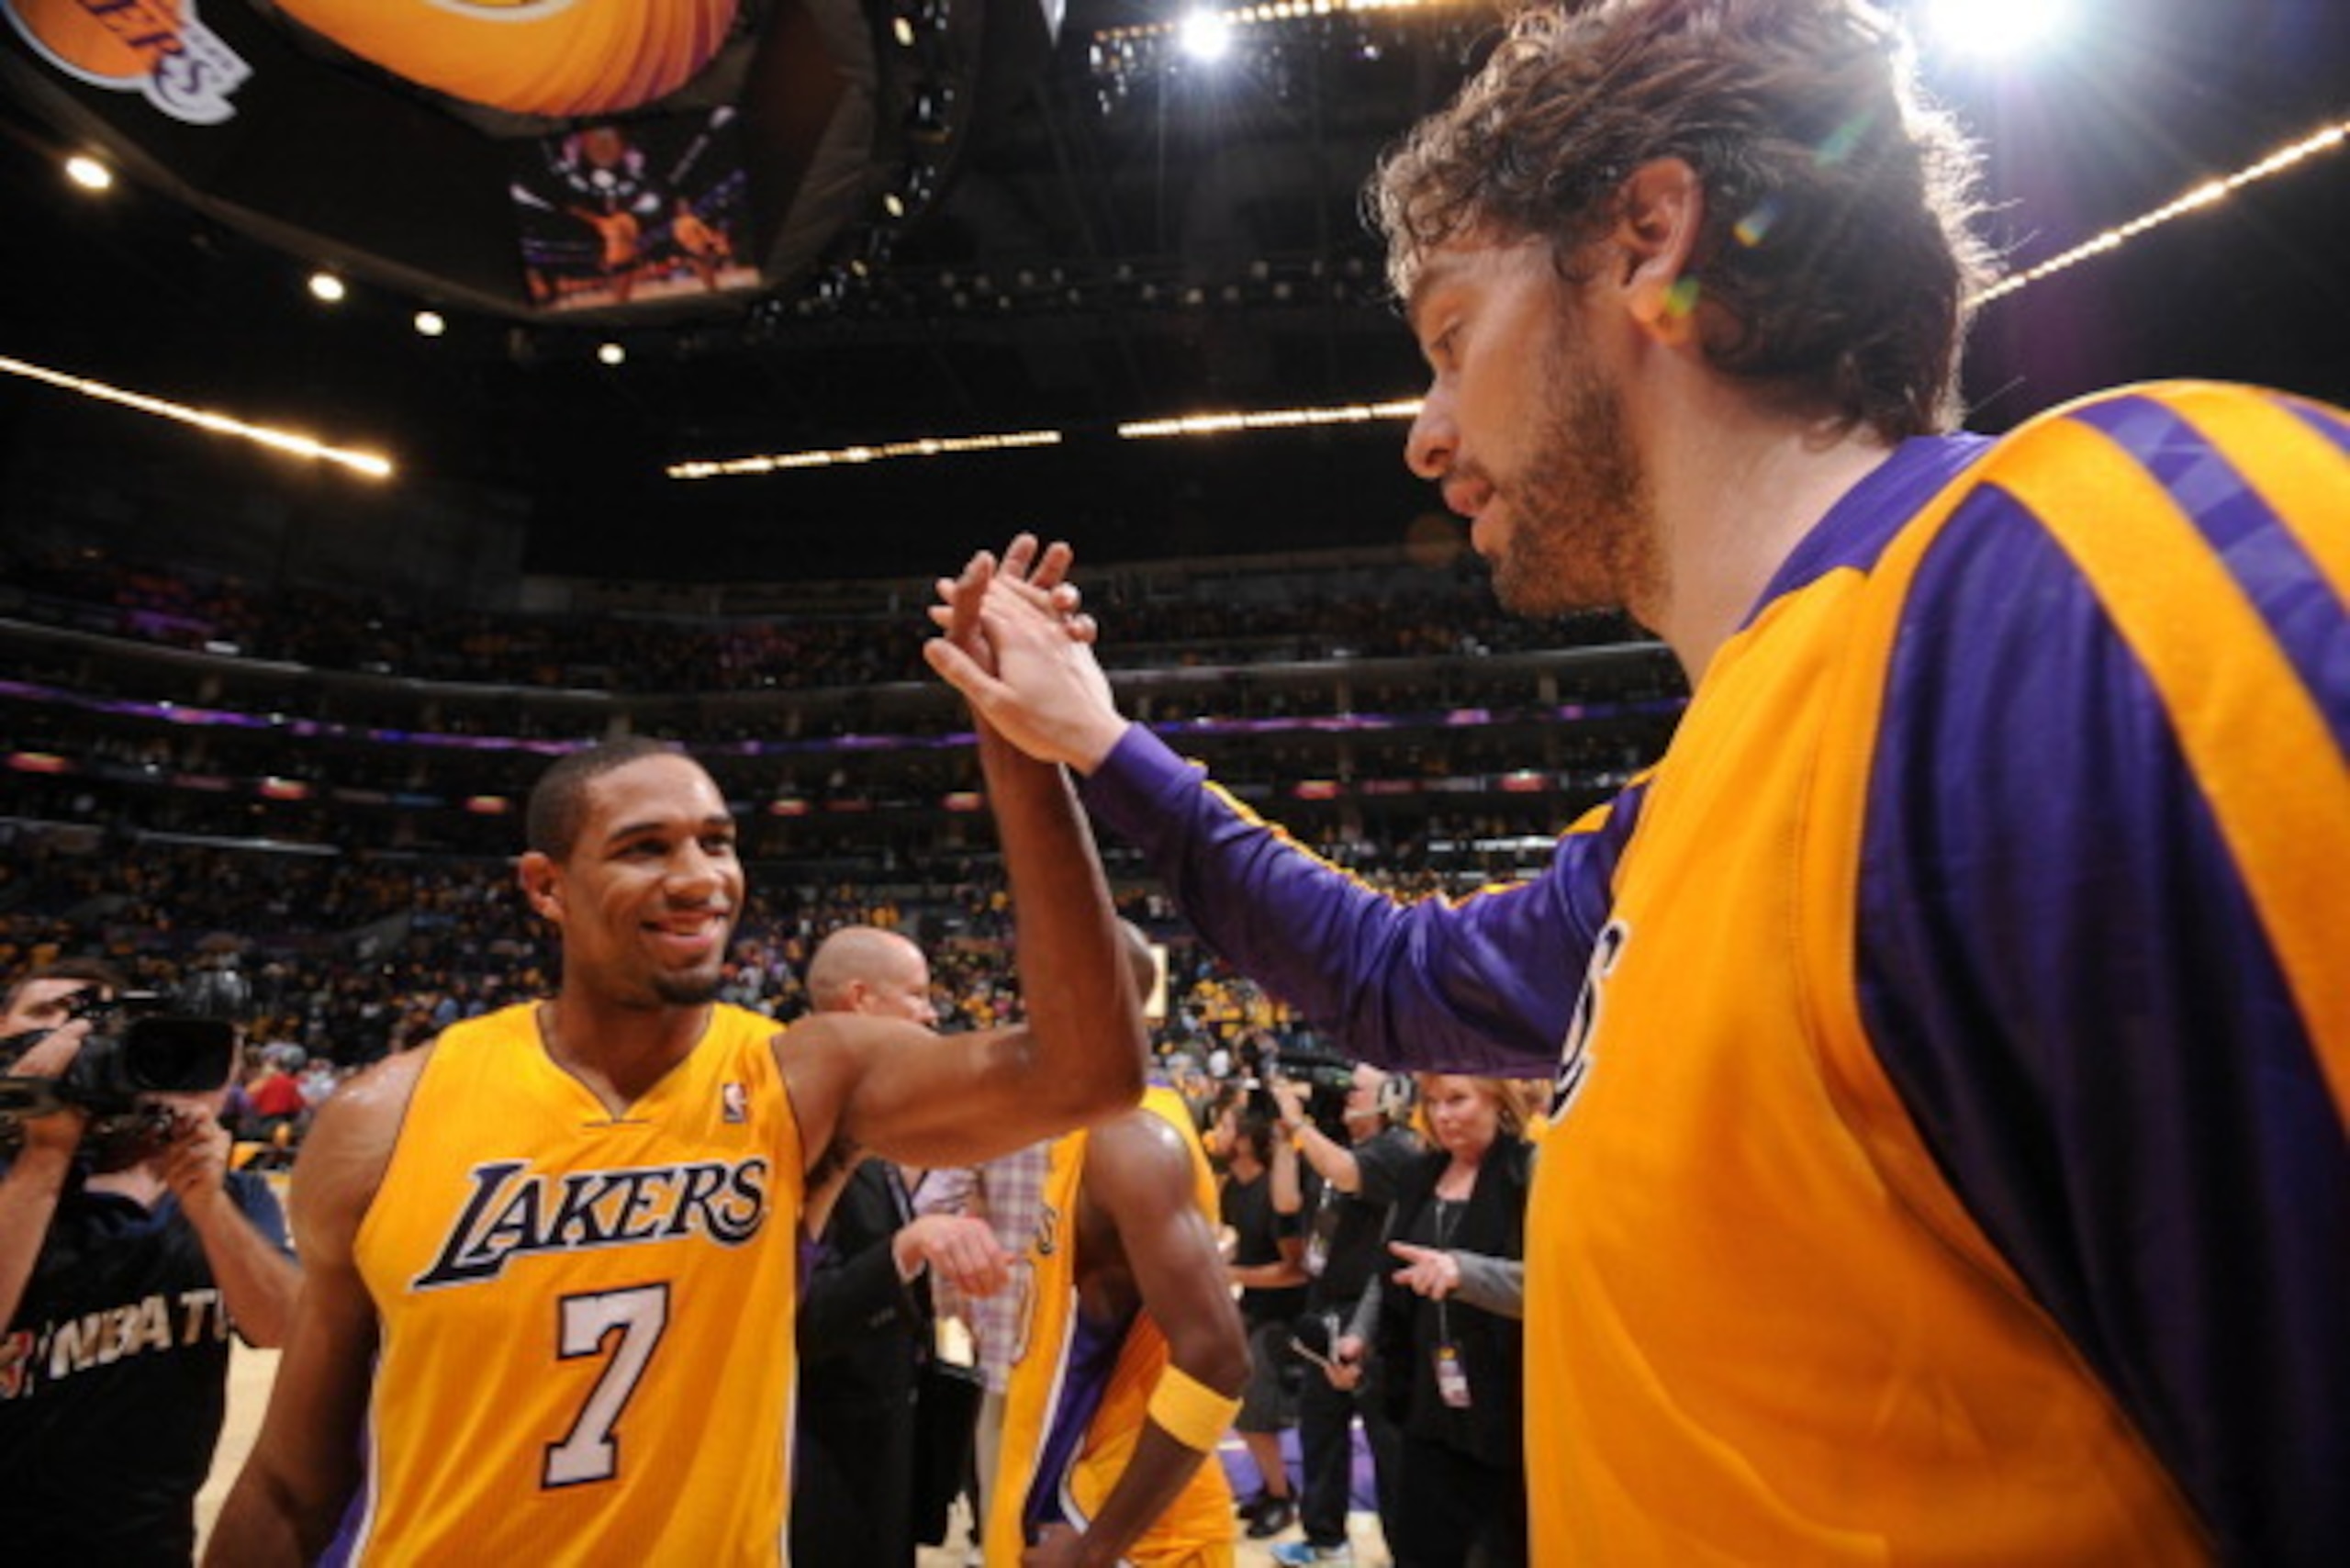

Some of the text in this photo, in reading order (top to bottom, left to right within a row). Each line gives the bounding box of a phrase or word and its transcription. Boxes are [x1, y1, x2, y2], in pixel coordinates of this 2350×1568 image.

[410, 1160, 769, 1290] LAKERS
[50, 1294, 173, 1379] NBA
[539, 1281, 671, 1490] 7
